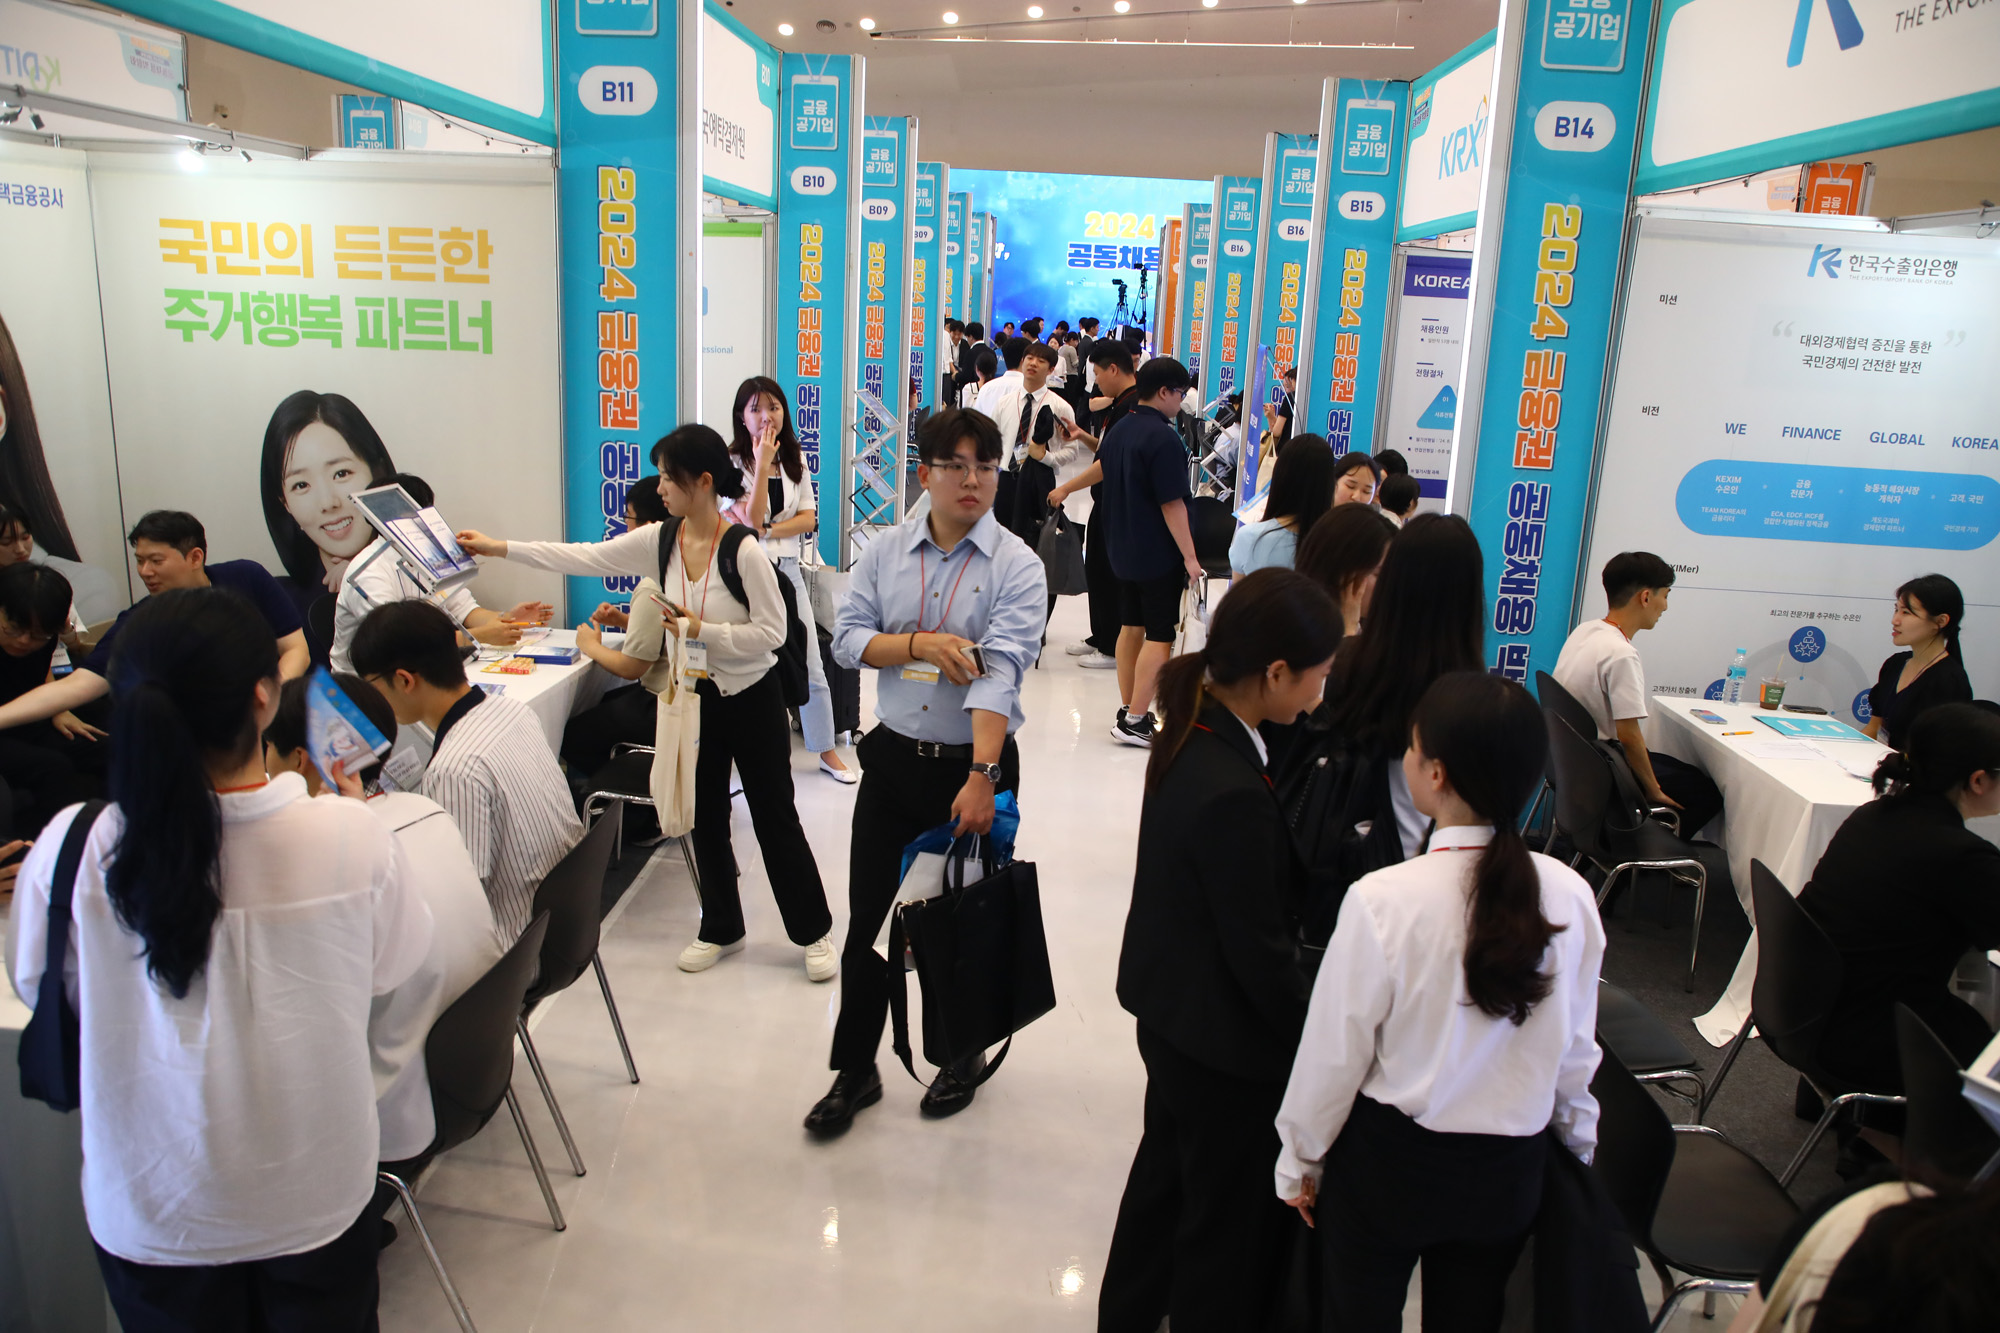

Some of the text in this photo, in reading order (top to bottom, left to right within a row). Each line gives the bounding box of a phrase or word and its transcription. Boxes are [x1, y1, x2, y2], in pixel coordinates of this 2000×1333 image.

[1554, 12, 1621, 41] 공기업
[1896, 4, 1927, 33] THE
[761, 63, 771, 87] B10
[602, 81, 634, 102] B11
[802, 100, 828, 115] 금융
[796, 117, 834, 133] 공기업
[1356, 124, 1382, 140] 금융
[1554, 117, 1595, 139] B14
[360, 128, 378, 140] 금융
[870, 148, 890, 161] 금융
[1348, 142, 1387, 158] 공기업
[1438, 118, 1484, 180] KRX
[865, 162, 894, 174] 공기업
[1291, 168, 1311, 181] 금융
[802, 175, 825, 188] B10
[1285, 180, 1315, 194] 공기업
[0, 182, 63, 209] 택금융공사
[916, 198, 932, 207] 기업
[1821, 196, 1841, 209] 금융
[869, 205, 888, 215] B09
[1233, 201, 1248, 211] 금융
[1350, 200, 1373, 213] B15
[1229, 211, 1251, 221] 공기업
[1085, 211, 1155, 239] 2024
[1287, 225, 1305, 236] B16
[598, 166, 637, 302] 2024
[159, 218, 494, 284] 국민의 든든한
[1231, 244, 1244, 252] B16
[798, 224, 824, 303] 2024
[1530, 203, 1582, 341] 2024
[1849, 254, 1958, 278] 한국수출입은행
[867, 241, 887, 304] 2024
[912, 258, 926, 303] 2024
[1414, 274, 1471, 289] KOREA
[1193, 281, 1206, 318] 2024
[1225, 273, 1242, 318] 2024
[1279, 262, 1301, 323] 2024
[1659, 294, 1678, 306] 미션
[163, 288, 494, 355] 주거행복 파트너
[911, 306, 926, 347] 금융권
[1421, 324, 1449, 335] 채용인원
[864, 306, 886, 360] 금융권
[797, 307, 823, 378] 금융권
[1221, 321, 1239, 363] 금융권
[1799, 333, 1933, 355] 대외경제협력 증진을 통한
[1326, 249, 1368, 461] 2024 금융권 공동
[599, 311, 639, 430] 금융권
[1802, 355, 1922, 374] 국민경제의 건전한 발전
[1416, 369, 1444, 379] 전형절차
[1513, 349, 1568, 471] 금융권
[1641, 404, 1660, 417] 비전
[1724, 422, 2000, 450] WE FINANCE GLOBAL KOREA
[1715, 475, 1742, 483] KEXIM
[1796, 479, 1812, 489] 금융
[1715, 485, 1739, 495] 수은인
[1790, 489, 1814, 499] 전문가
[1494, 481, 1552, 635] 공동채용
[1671, 564, 1700, 575] XIMer)
[1769, 609, 1862, 622] 최고의 전문가를 추구하는 수은인
[1651, 685, 1677, 694] 고객가치
